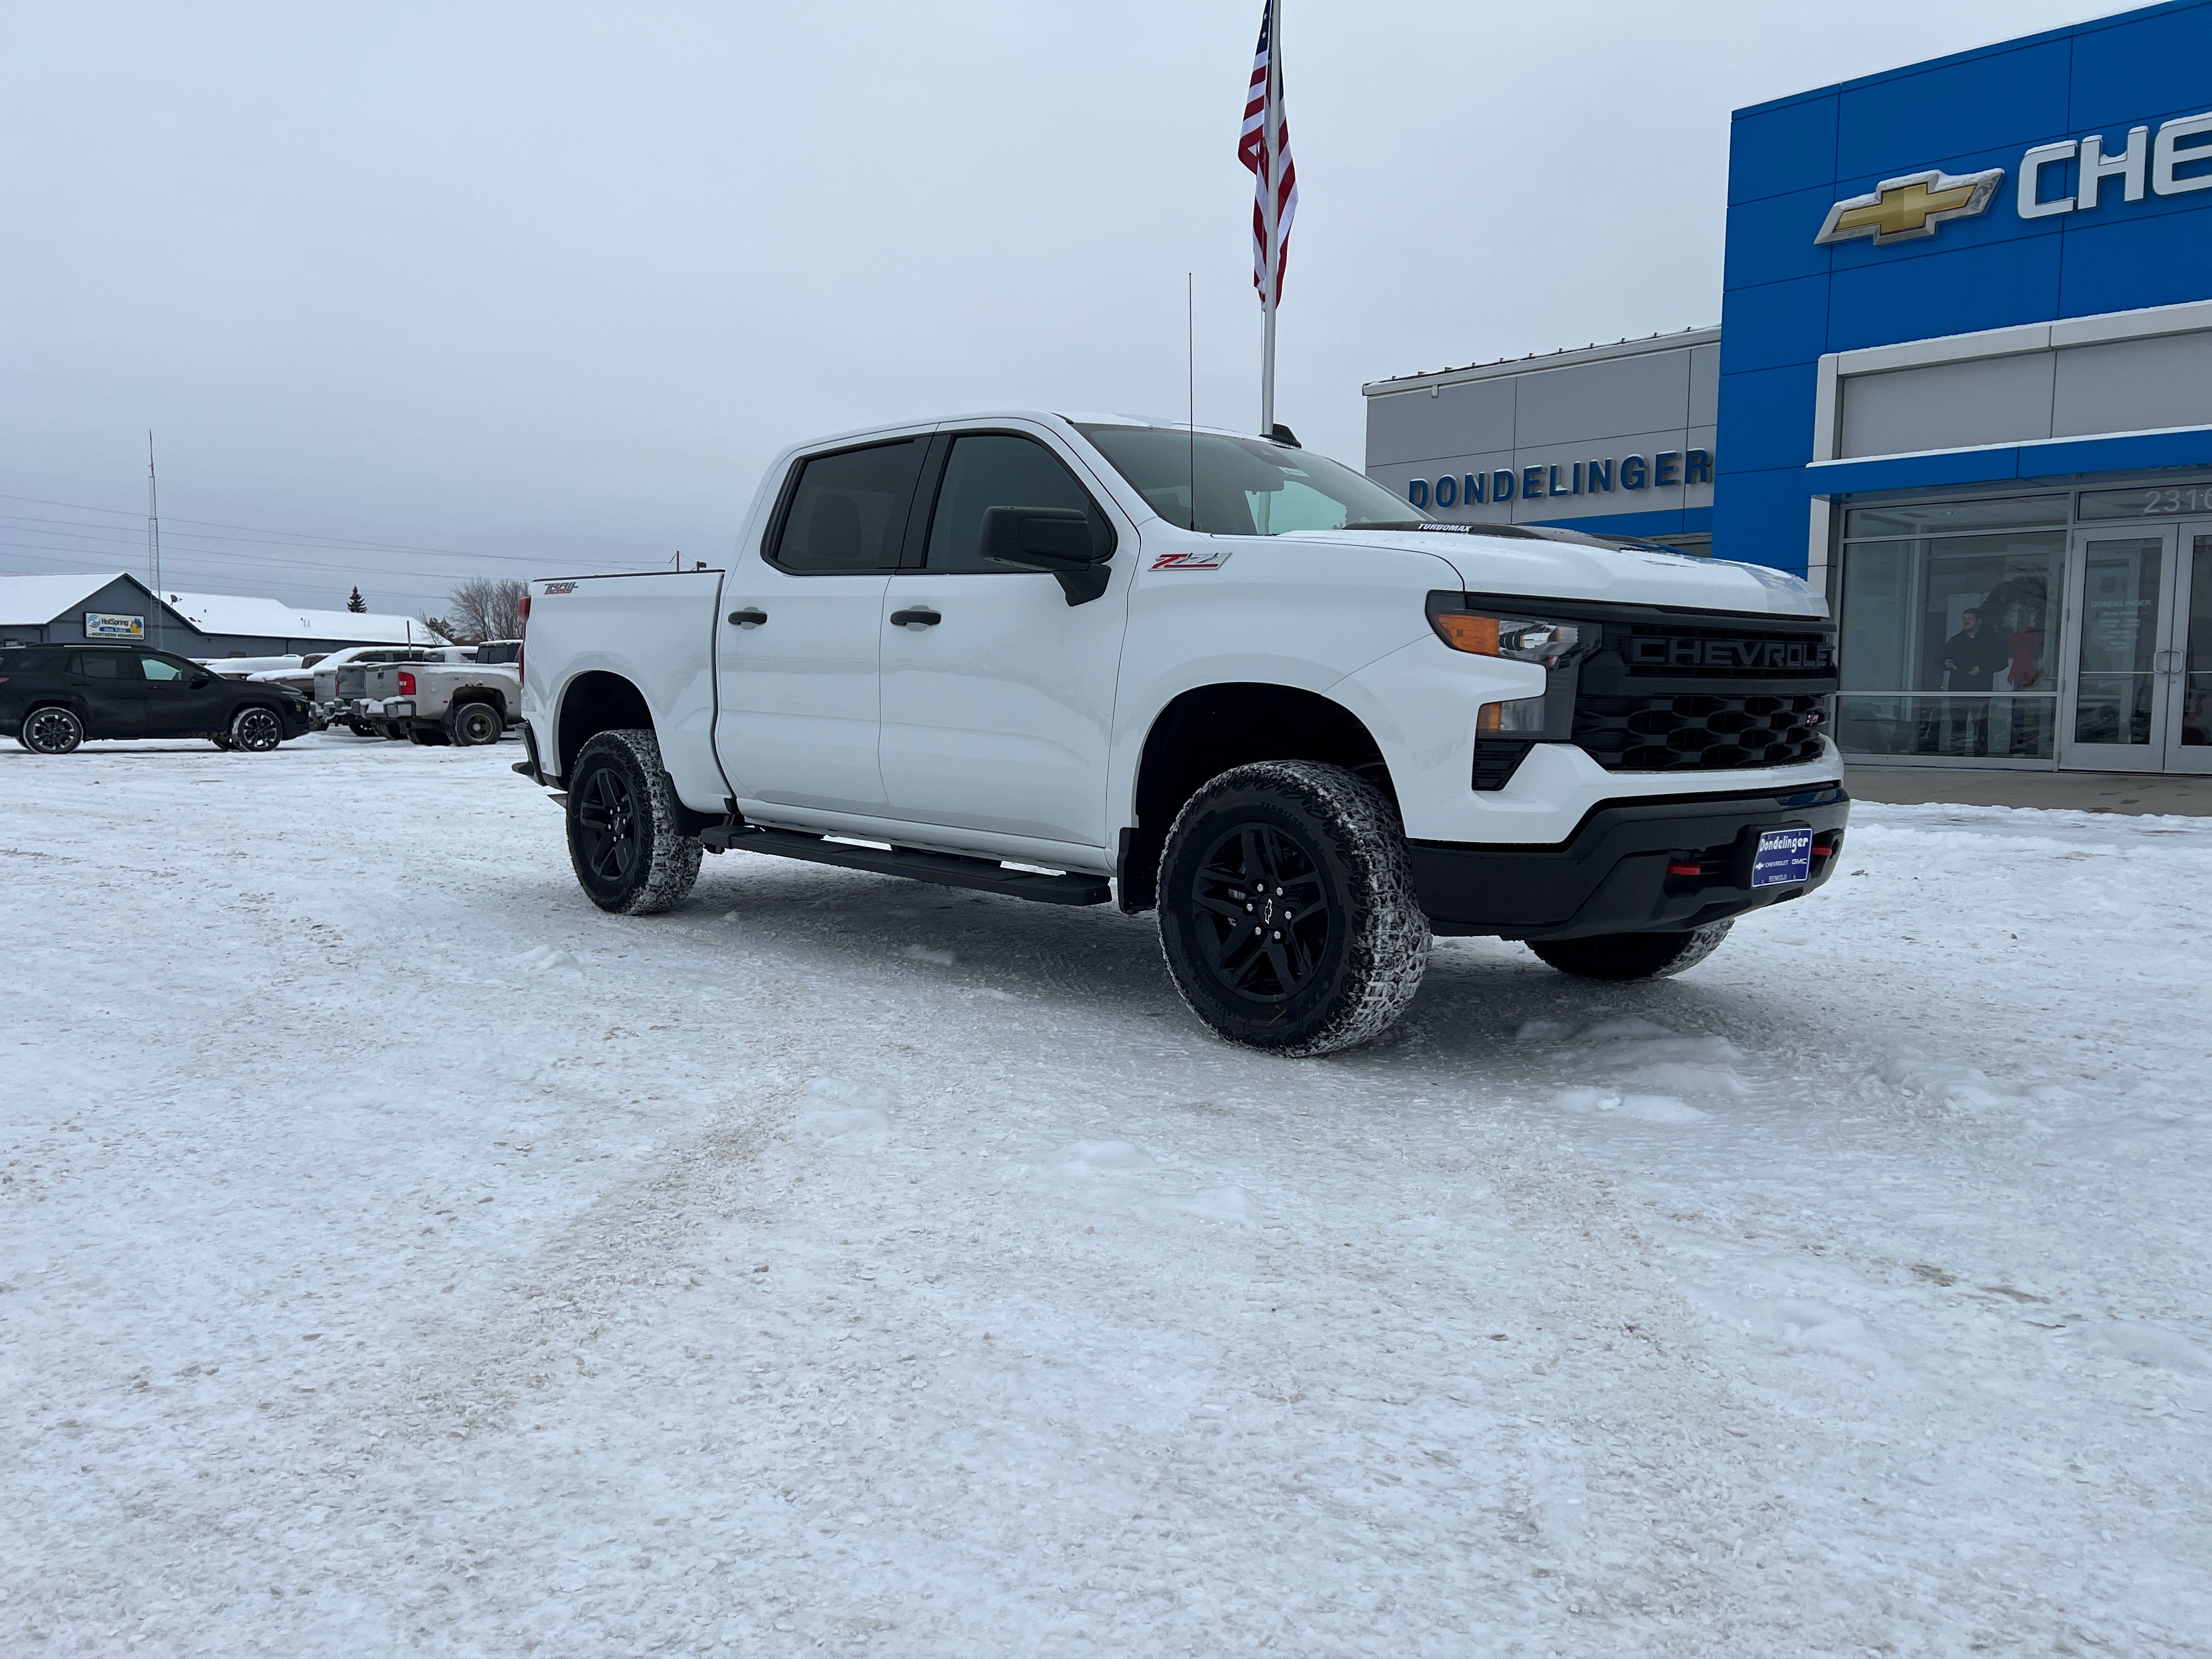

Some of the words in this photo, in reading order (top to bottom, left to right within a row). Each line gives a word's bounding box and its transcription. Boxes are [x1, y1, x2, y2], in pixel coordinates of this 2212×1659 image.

[1409, 448, 1712, 509] DONDELINGER
[1418, 523, 1472, 532] TURBOMAX
[1147, 552, 1233, 572] Z71
[544, 582, 579, 590] TRAIL
[2090, 599, 2152, 608] DONDELINGER
[101, 618, 129, 627] HotSpring
[1758, 835, 1809, 853] Dondelinger
[1765, 859, 1789, 868] CHEVROLET
[1768, 873, 1787, 882] BEMIDJI
